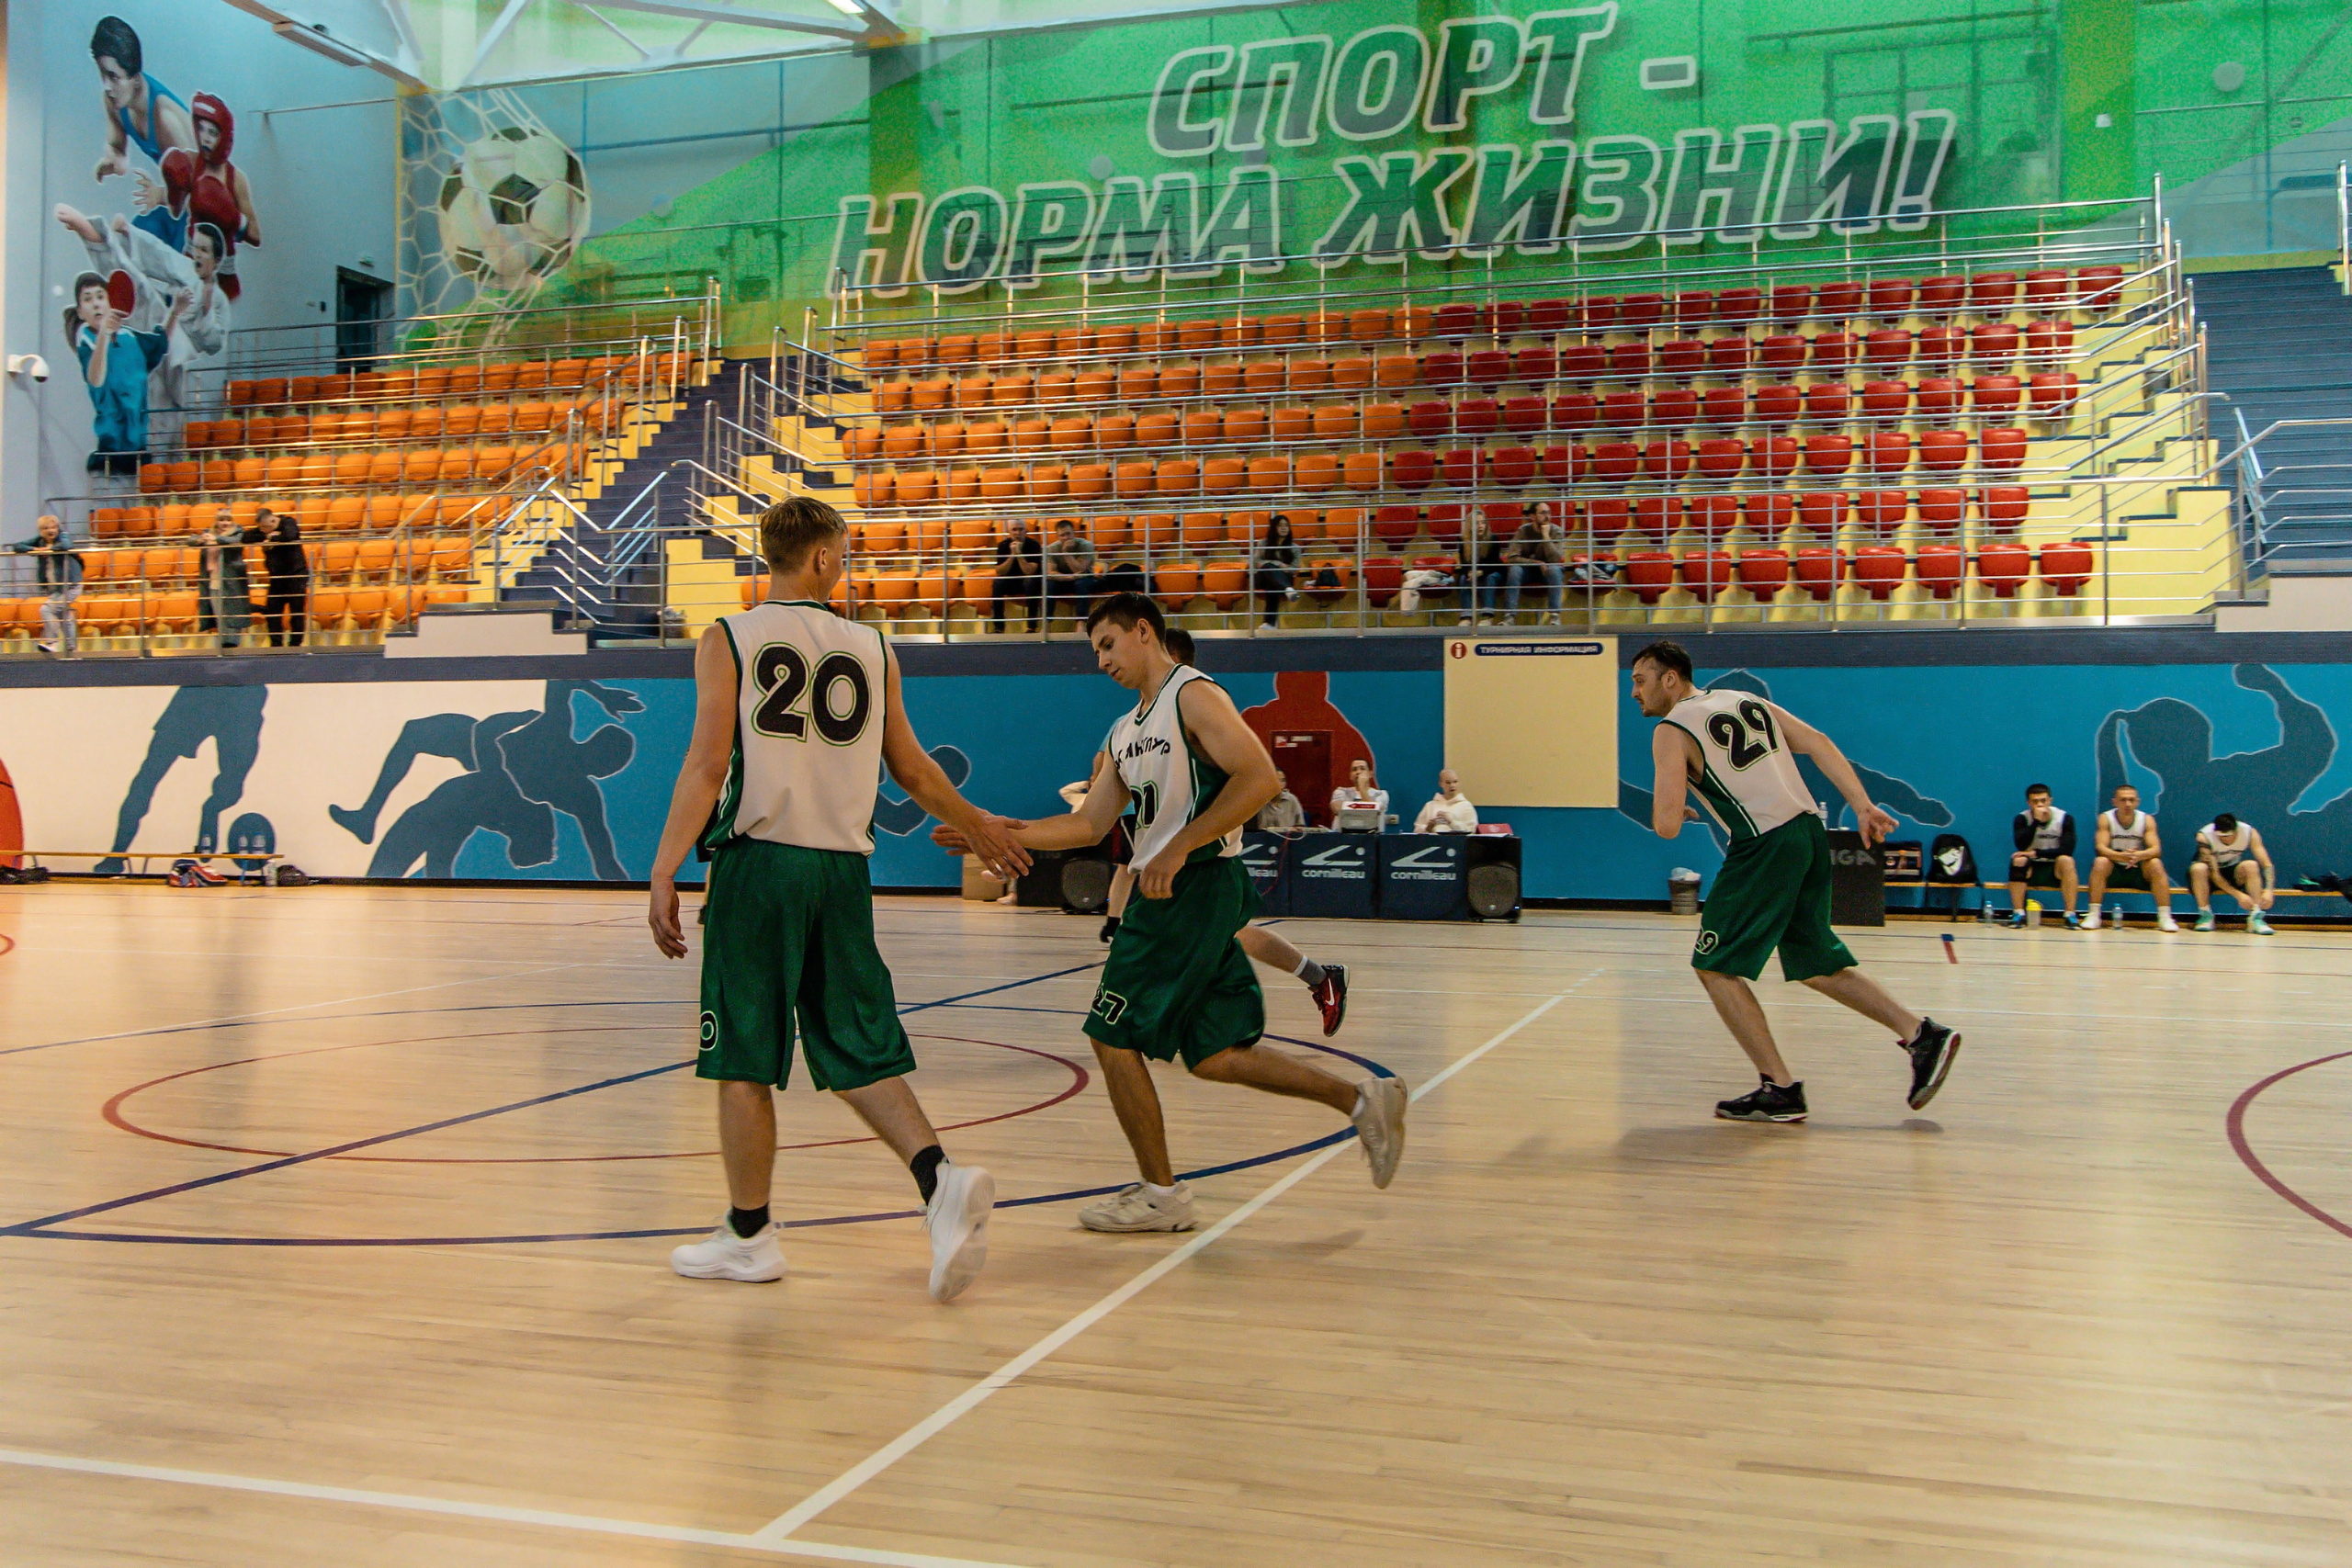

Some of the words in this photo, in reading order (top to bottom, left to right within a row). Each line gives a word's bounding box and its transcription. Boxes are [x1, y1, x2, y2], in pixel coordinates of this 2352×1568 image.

[1147, 1, 1619, 158] СПОРТ
[825, 164, 1285, 299] НОРМА
[1311, 108, 1957, 269] ЖИЗНИ!
[1533, 645, 1598, 655] ИНФОРМАЦИЯ
[751, 641, 872, 747] 20
[1705, 698, 1780, 772] 29
[1302, 868, 1366, 879] cornilleau
[1390, 870, 1457, 881] cornilleau
[1828, 849, 1877, 866] IGA
